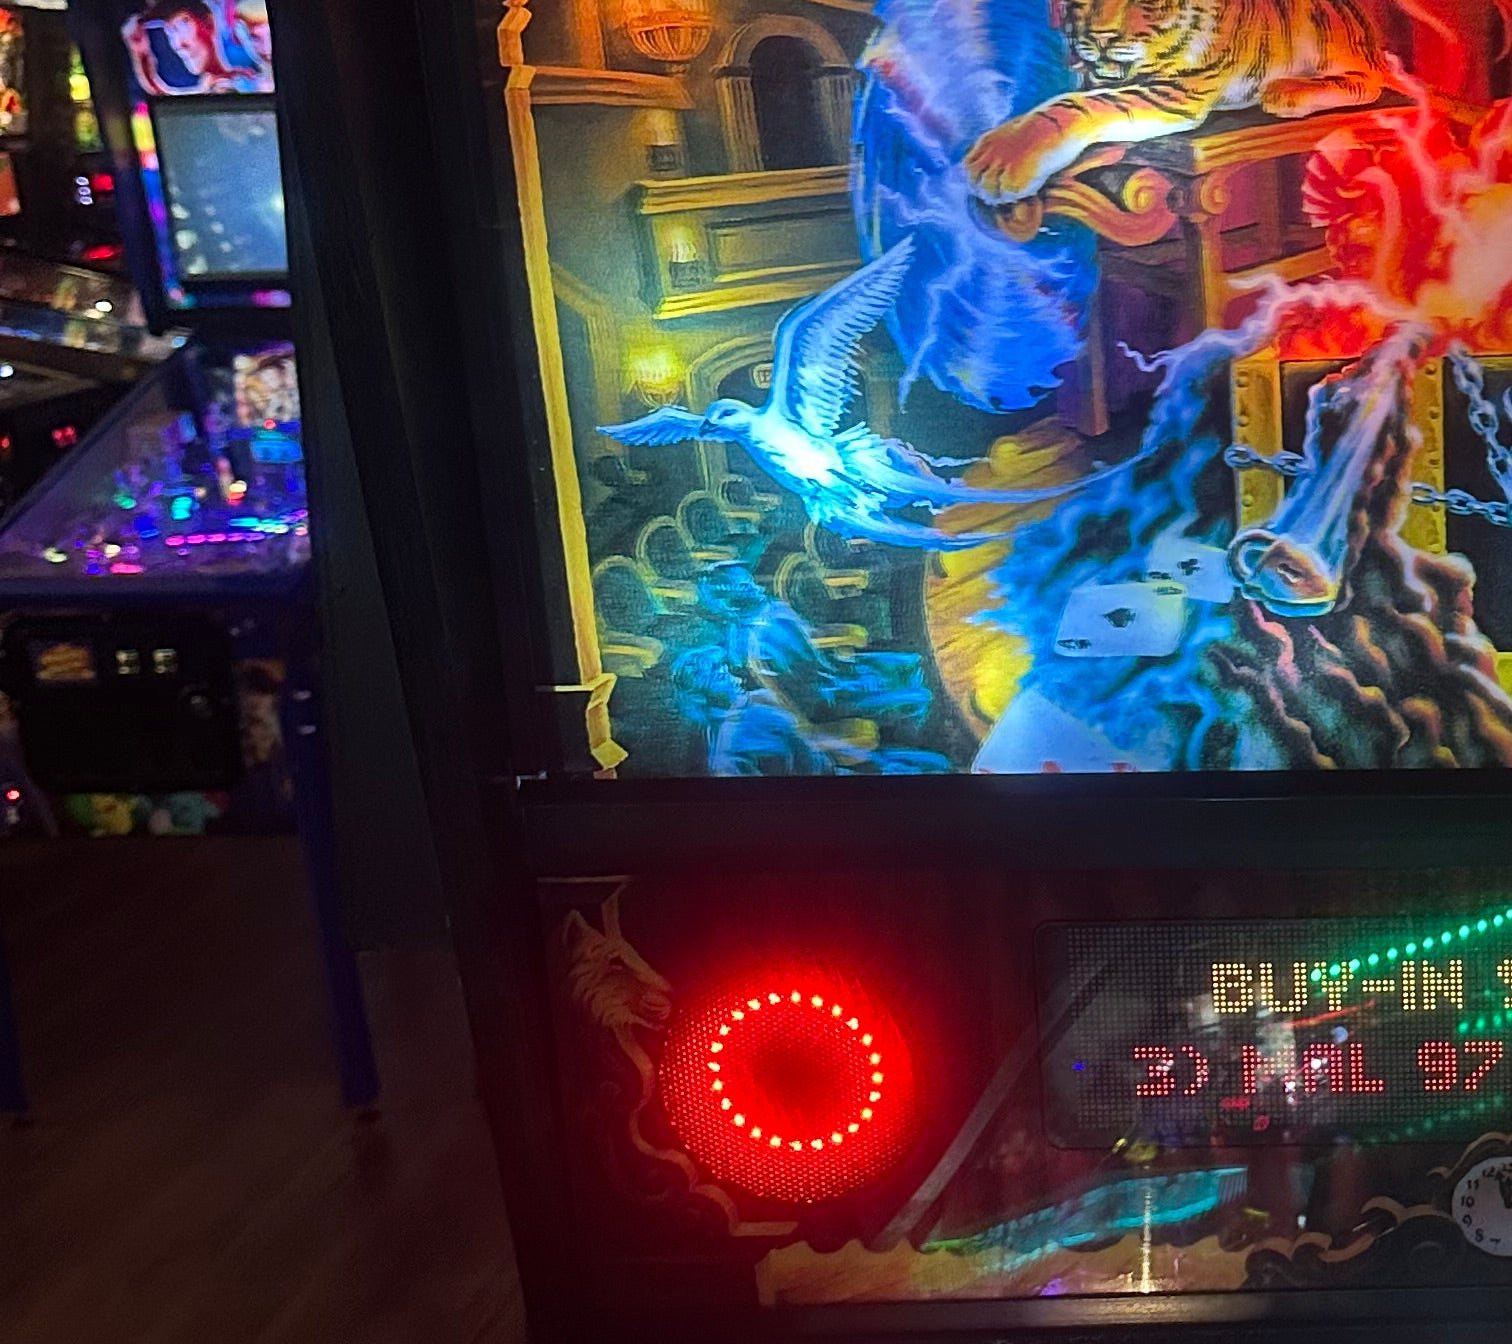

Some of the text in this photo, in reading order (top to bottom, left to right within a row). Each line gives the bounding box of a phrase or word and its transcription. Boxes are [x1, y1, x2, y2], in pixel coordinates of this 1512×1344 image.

[1211, 959, 1463, 1013] BUY-IN
[1133, 1045, 1210, 1096] 3)
[1467, 1179, 1479, 1190] 11
[1461, 1196, 1475, 1208] 10
[1462, 1214, 1473, 1228] 9
[1475, 1228, 1484, 1242] 8
